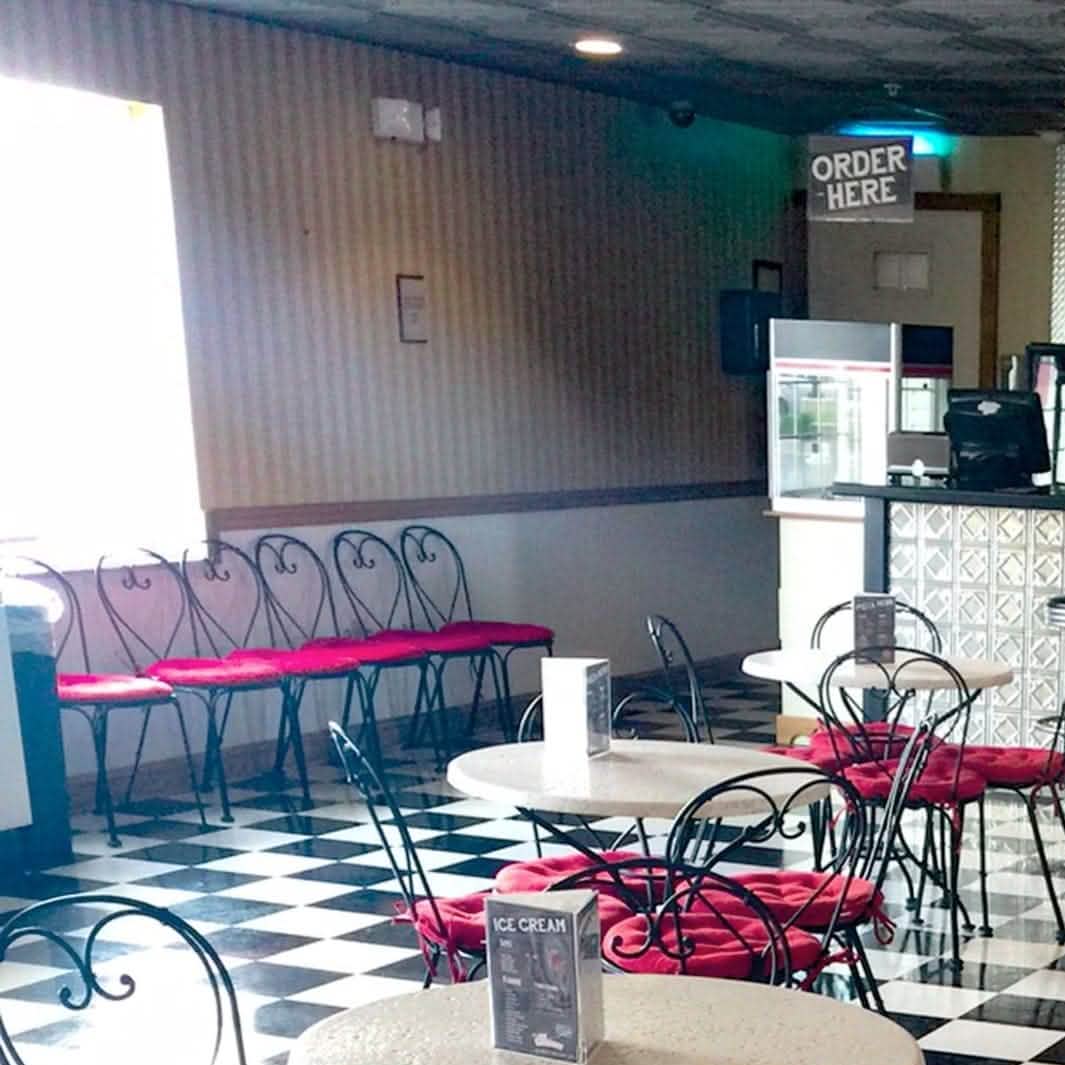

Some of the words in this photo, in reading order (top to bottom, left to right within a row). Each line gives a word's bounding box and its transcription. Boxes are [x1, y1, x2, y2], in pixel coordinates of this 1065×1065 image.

[811, 144, 907, 182] ORDER
[826, 176, 897, 210] HERE
[492, 917, 515, 932] ICE
[518, 917, 567, 933] CREAM
